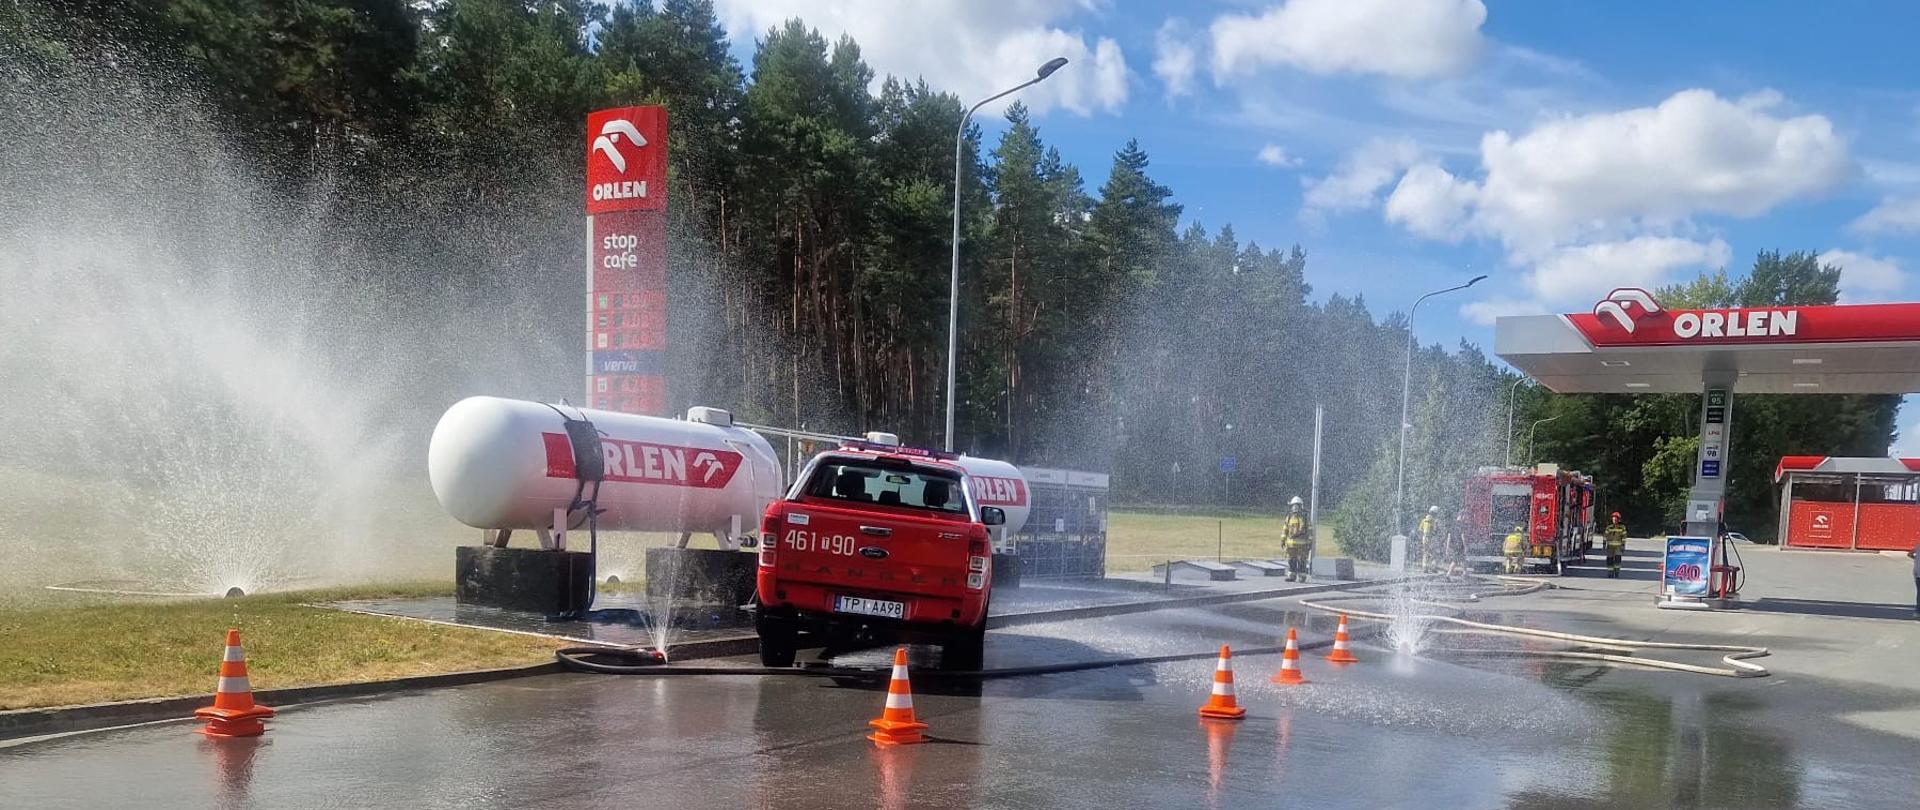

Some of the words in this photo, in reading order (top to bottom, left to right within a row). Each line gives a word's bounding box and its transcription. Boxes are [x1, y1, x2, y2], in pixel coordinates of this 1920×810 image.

[593, 181, 647, 201] ORLEN
[603, 233, 637, 252] stop
[603, 252, 637, 269] cafe
[1673, 311, 1797, 339] ORLEN
[604, 360, 637, 372] verva
[568, 436, 686, 481] RLEN
[785, 530, 816, 552] 461
[832, 535, 855, 556] 90
[843, 598, 866, 609] TPI
[872, 602, 902, 615] AA98
